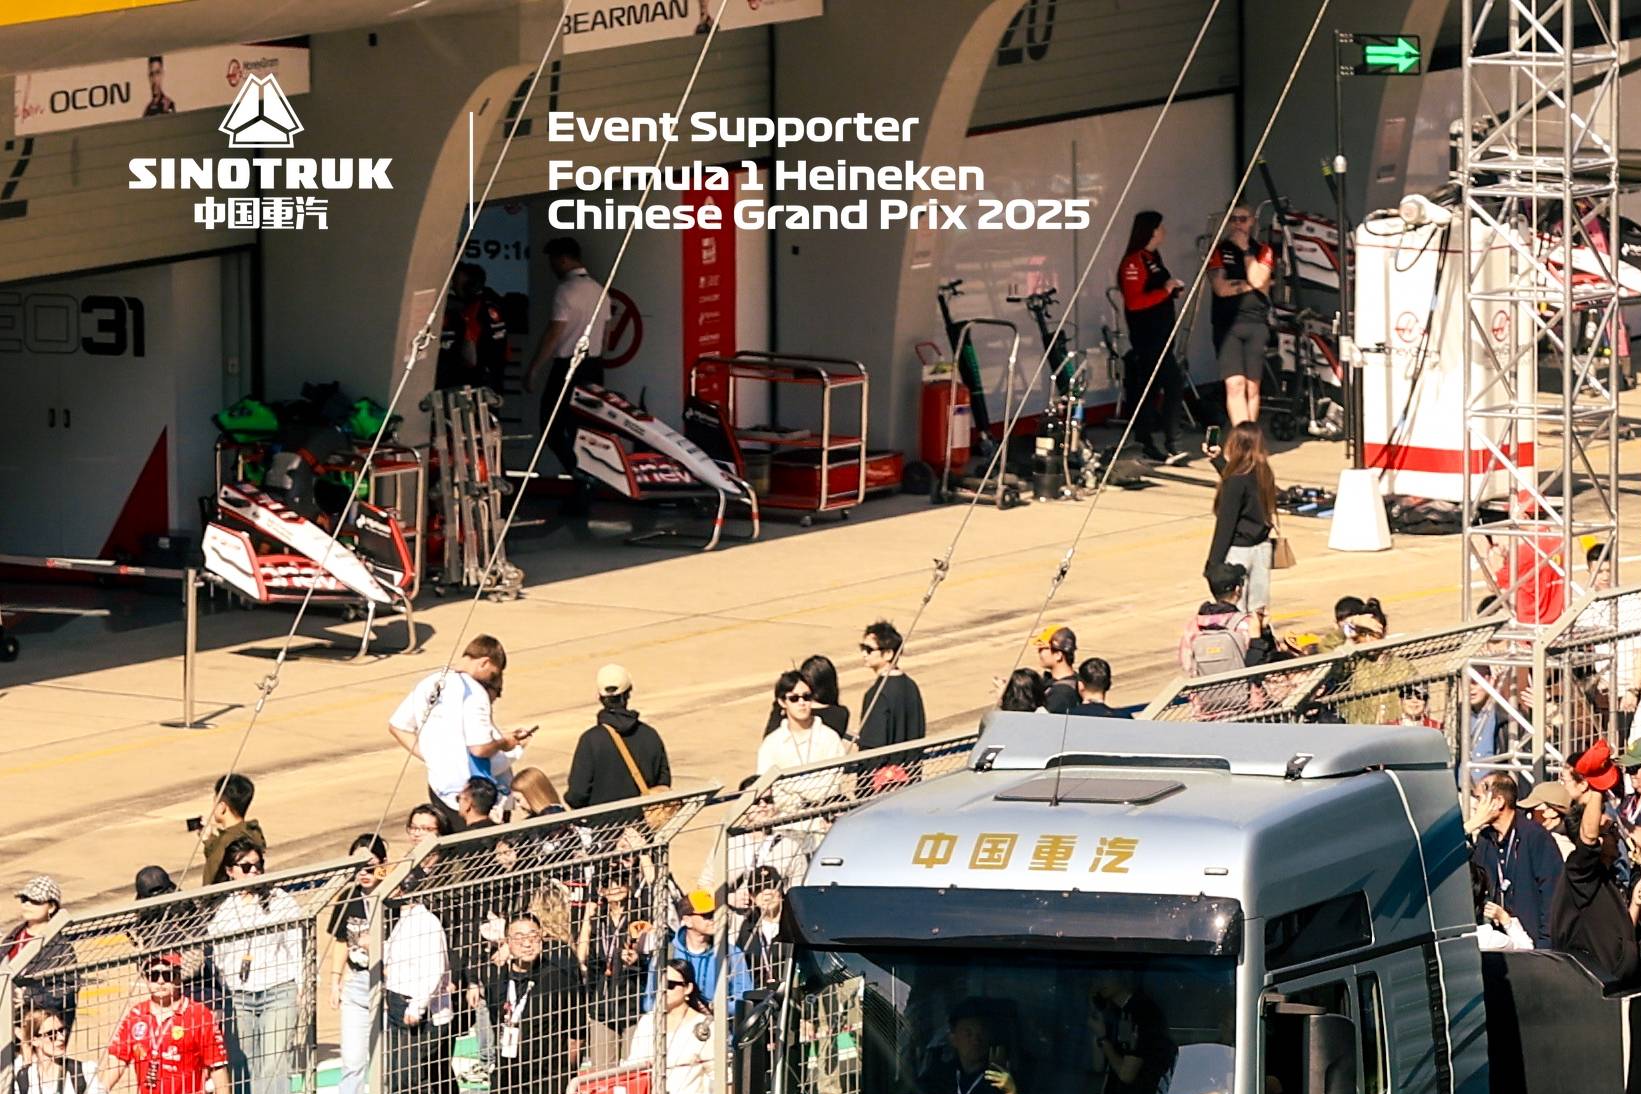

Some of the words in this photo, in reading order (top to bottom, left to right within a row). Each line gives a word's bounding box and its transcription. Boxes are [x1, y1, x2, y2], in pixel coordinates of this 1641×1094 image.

[562, 0, 689, 36] BEARMAN
[50, 81, 131, 115] OCON
[911, 831, 1140, 874] 中国重汽
